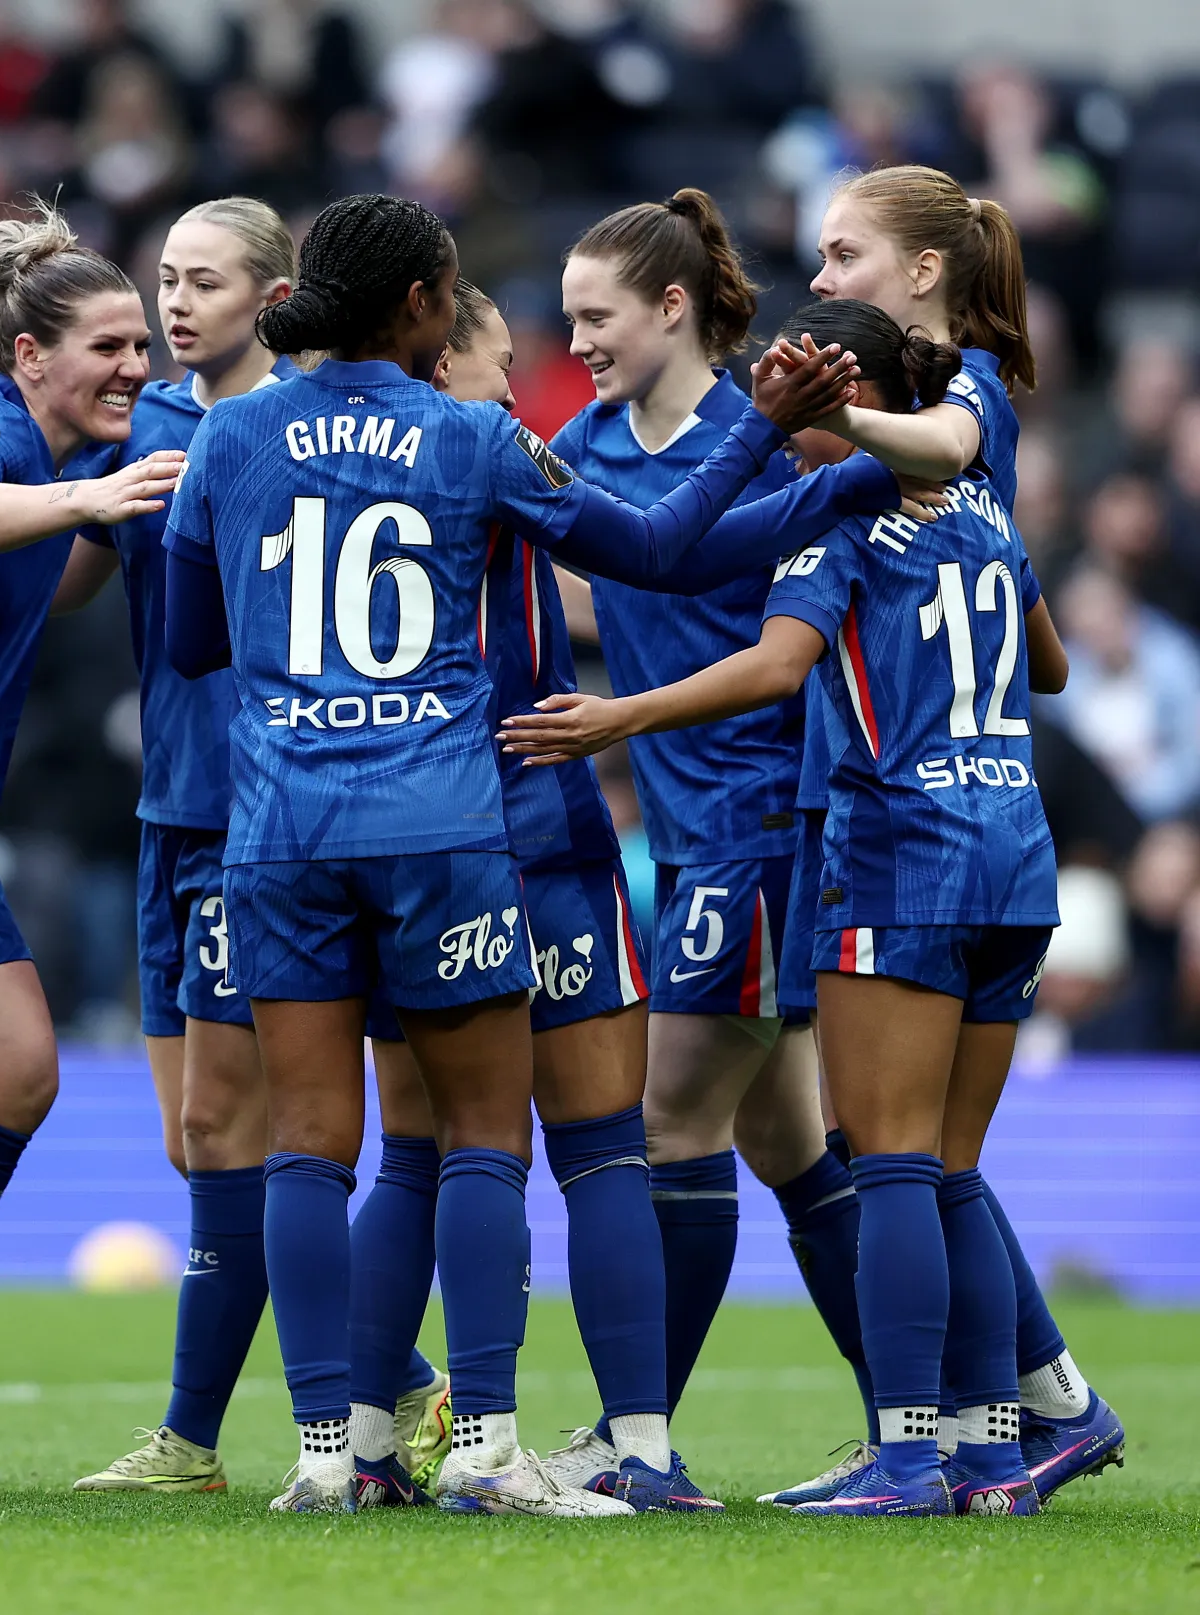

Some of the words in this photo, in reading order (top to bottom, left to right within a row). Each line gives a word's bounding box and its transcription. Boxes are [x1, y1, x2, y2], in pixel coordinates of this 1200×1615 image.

[348, 396, 365, 404] CFC
[285, 415, 423, 469] GIRMA
[868, 481, 1011, 555] THPSON
[260, 496, 436, 680] 16
[918, 560, 1031, 739] 12
[916, 755, 1038, 790] SKOD
[437, 912, 514, 980] Flo
[681, 886, 729, 961] 5
[189, 1247, 219, 1265] CFC
[1049, 1356, 1073, 1394] ESIGN
